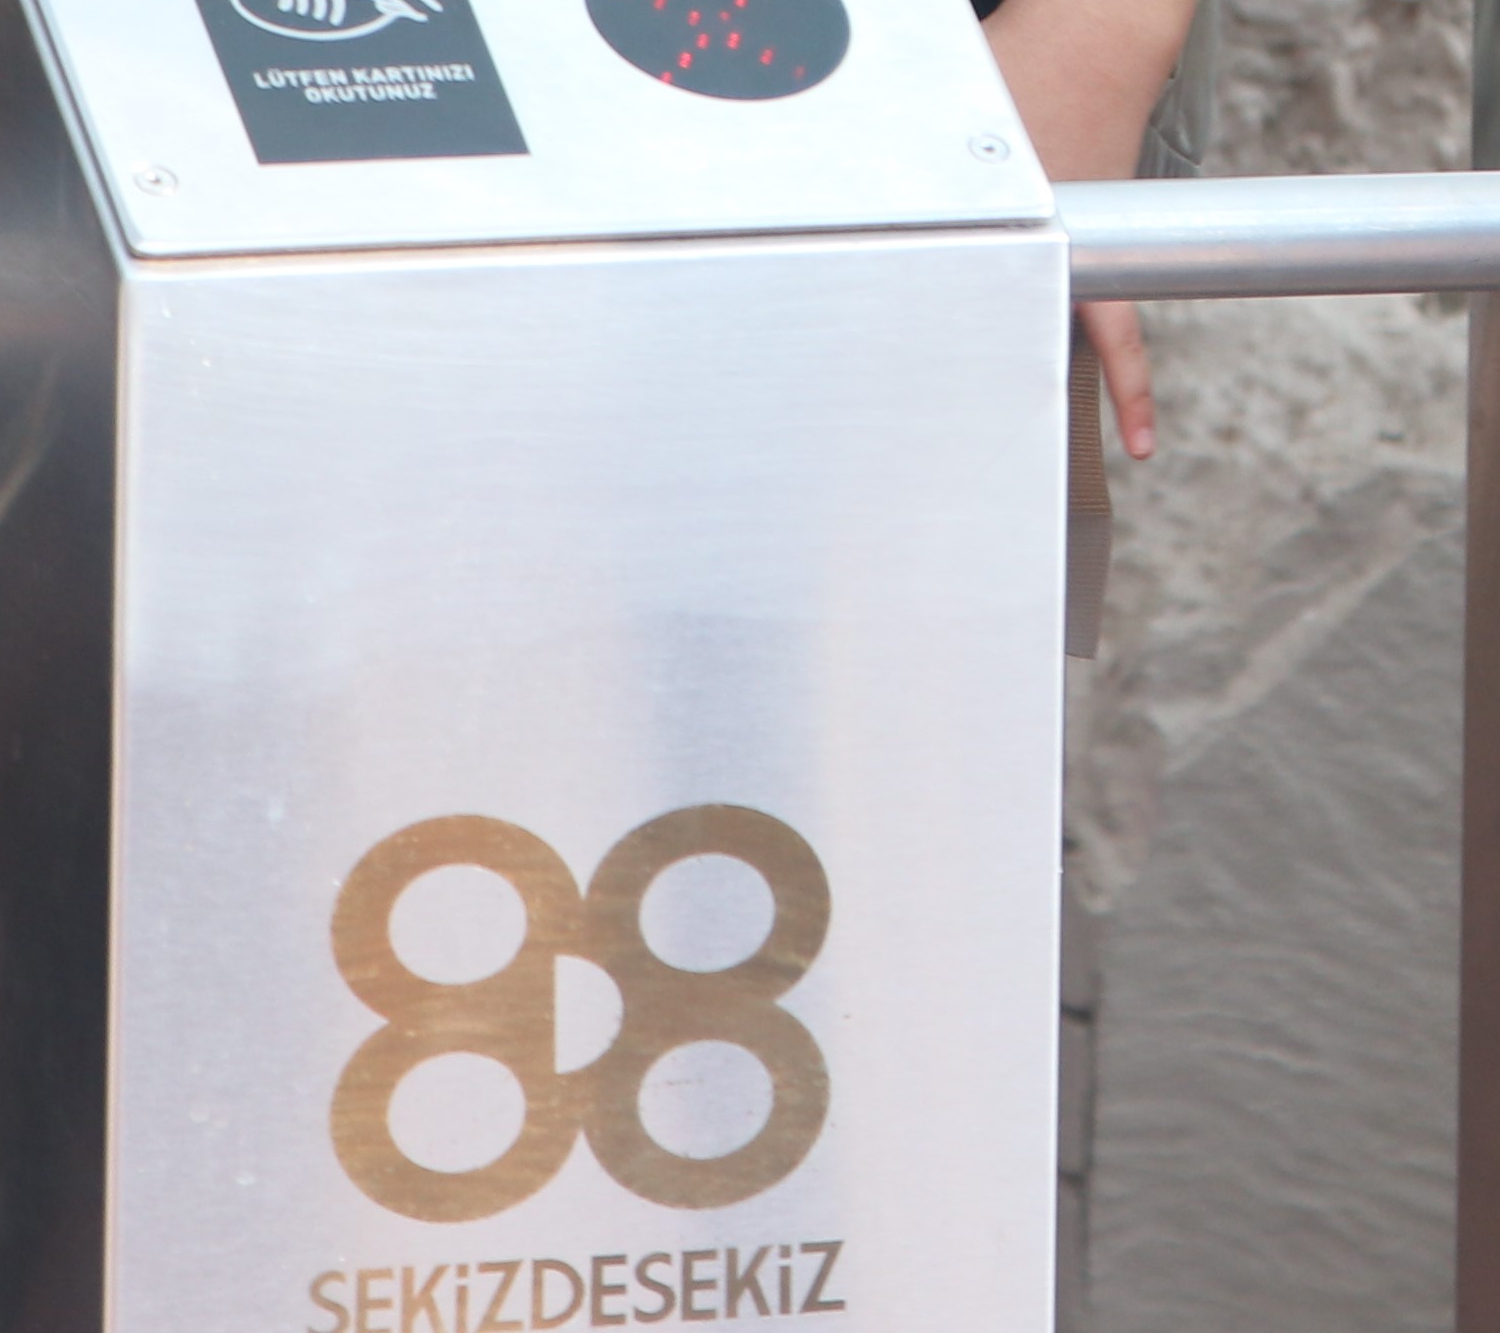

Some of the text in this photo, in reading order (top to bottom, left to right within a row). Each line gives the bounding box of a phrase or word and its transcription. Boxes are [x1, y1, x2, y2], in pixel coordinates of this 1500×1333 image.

[252, 63, 476, 90] LÜTFEN KARTINIZI
[303, 82, 438, 104] OKUTUNUZ
